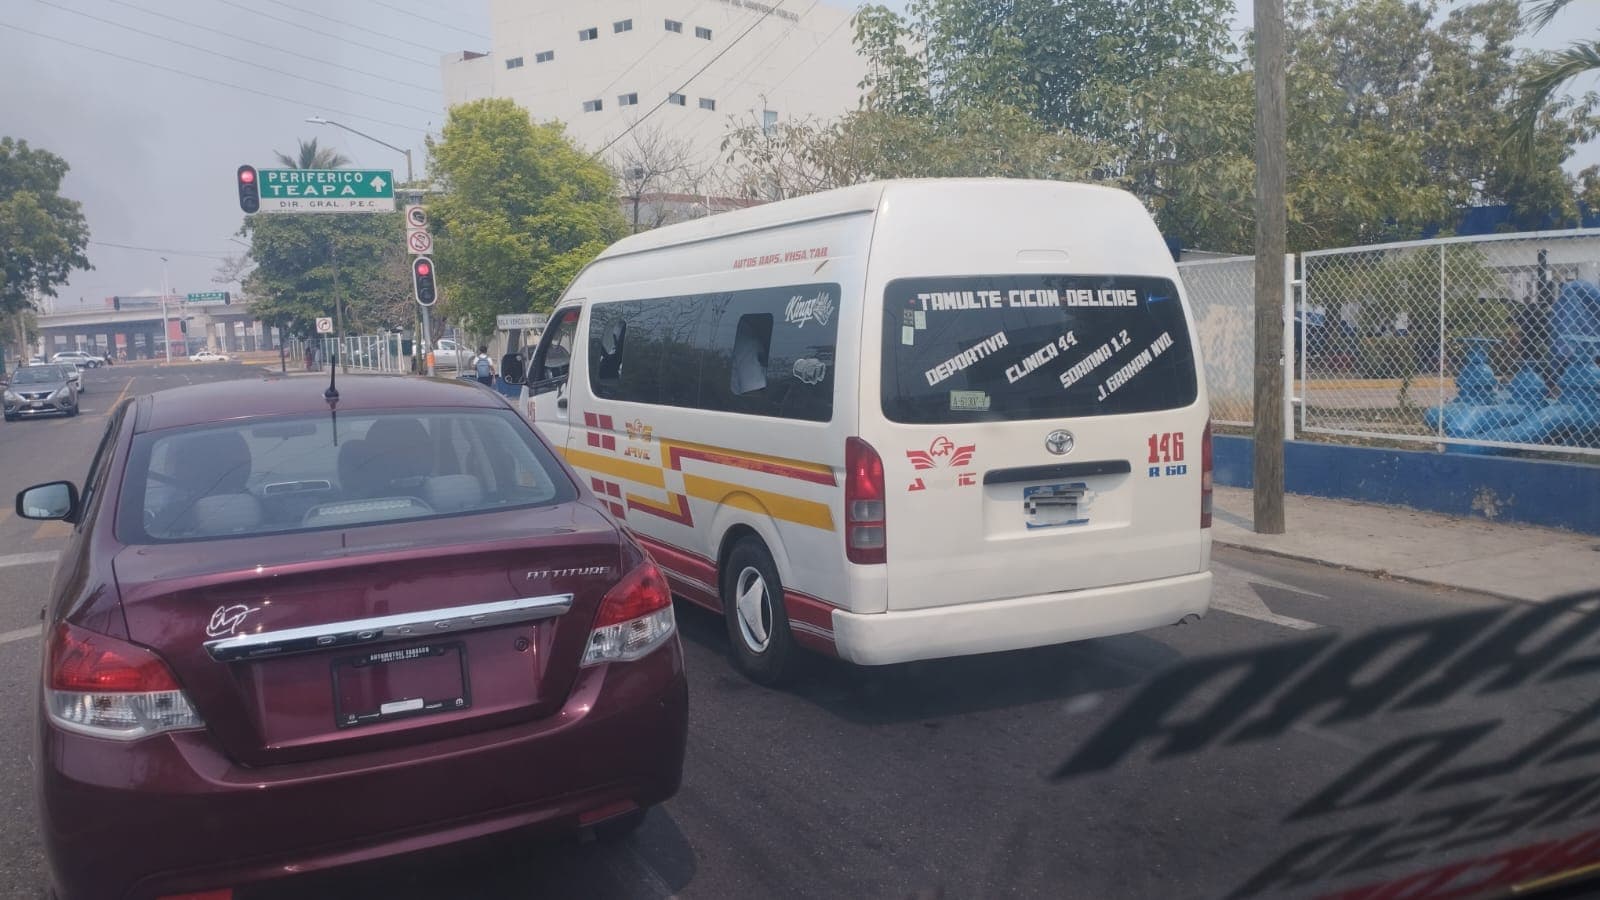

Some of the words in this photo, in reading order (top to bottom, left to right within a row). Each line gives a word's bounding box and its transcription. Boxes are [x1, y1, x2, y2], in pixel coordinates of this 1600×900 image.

[268, 172, 363, 182] PERIFERICO
[269, 184, 356, 196] TEAPA
[917, 290, 1002, 311] TAMULTE
[1008, 290, 1060, 308] CICOM
[1065, 289, 1138, 307] DELICIAS
[924, 330, 1009, 387] DEPORTIVA
[1005, 342, 1059, 384] CLINICA
[1058, 330, 1078, 351] 44
[1148, 432, 1185, 464] 146
[1149, 466, 1160, 478] R
[526, 566, 609, 580] ATTITUDE
